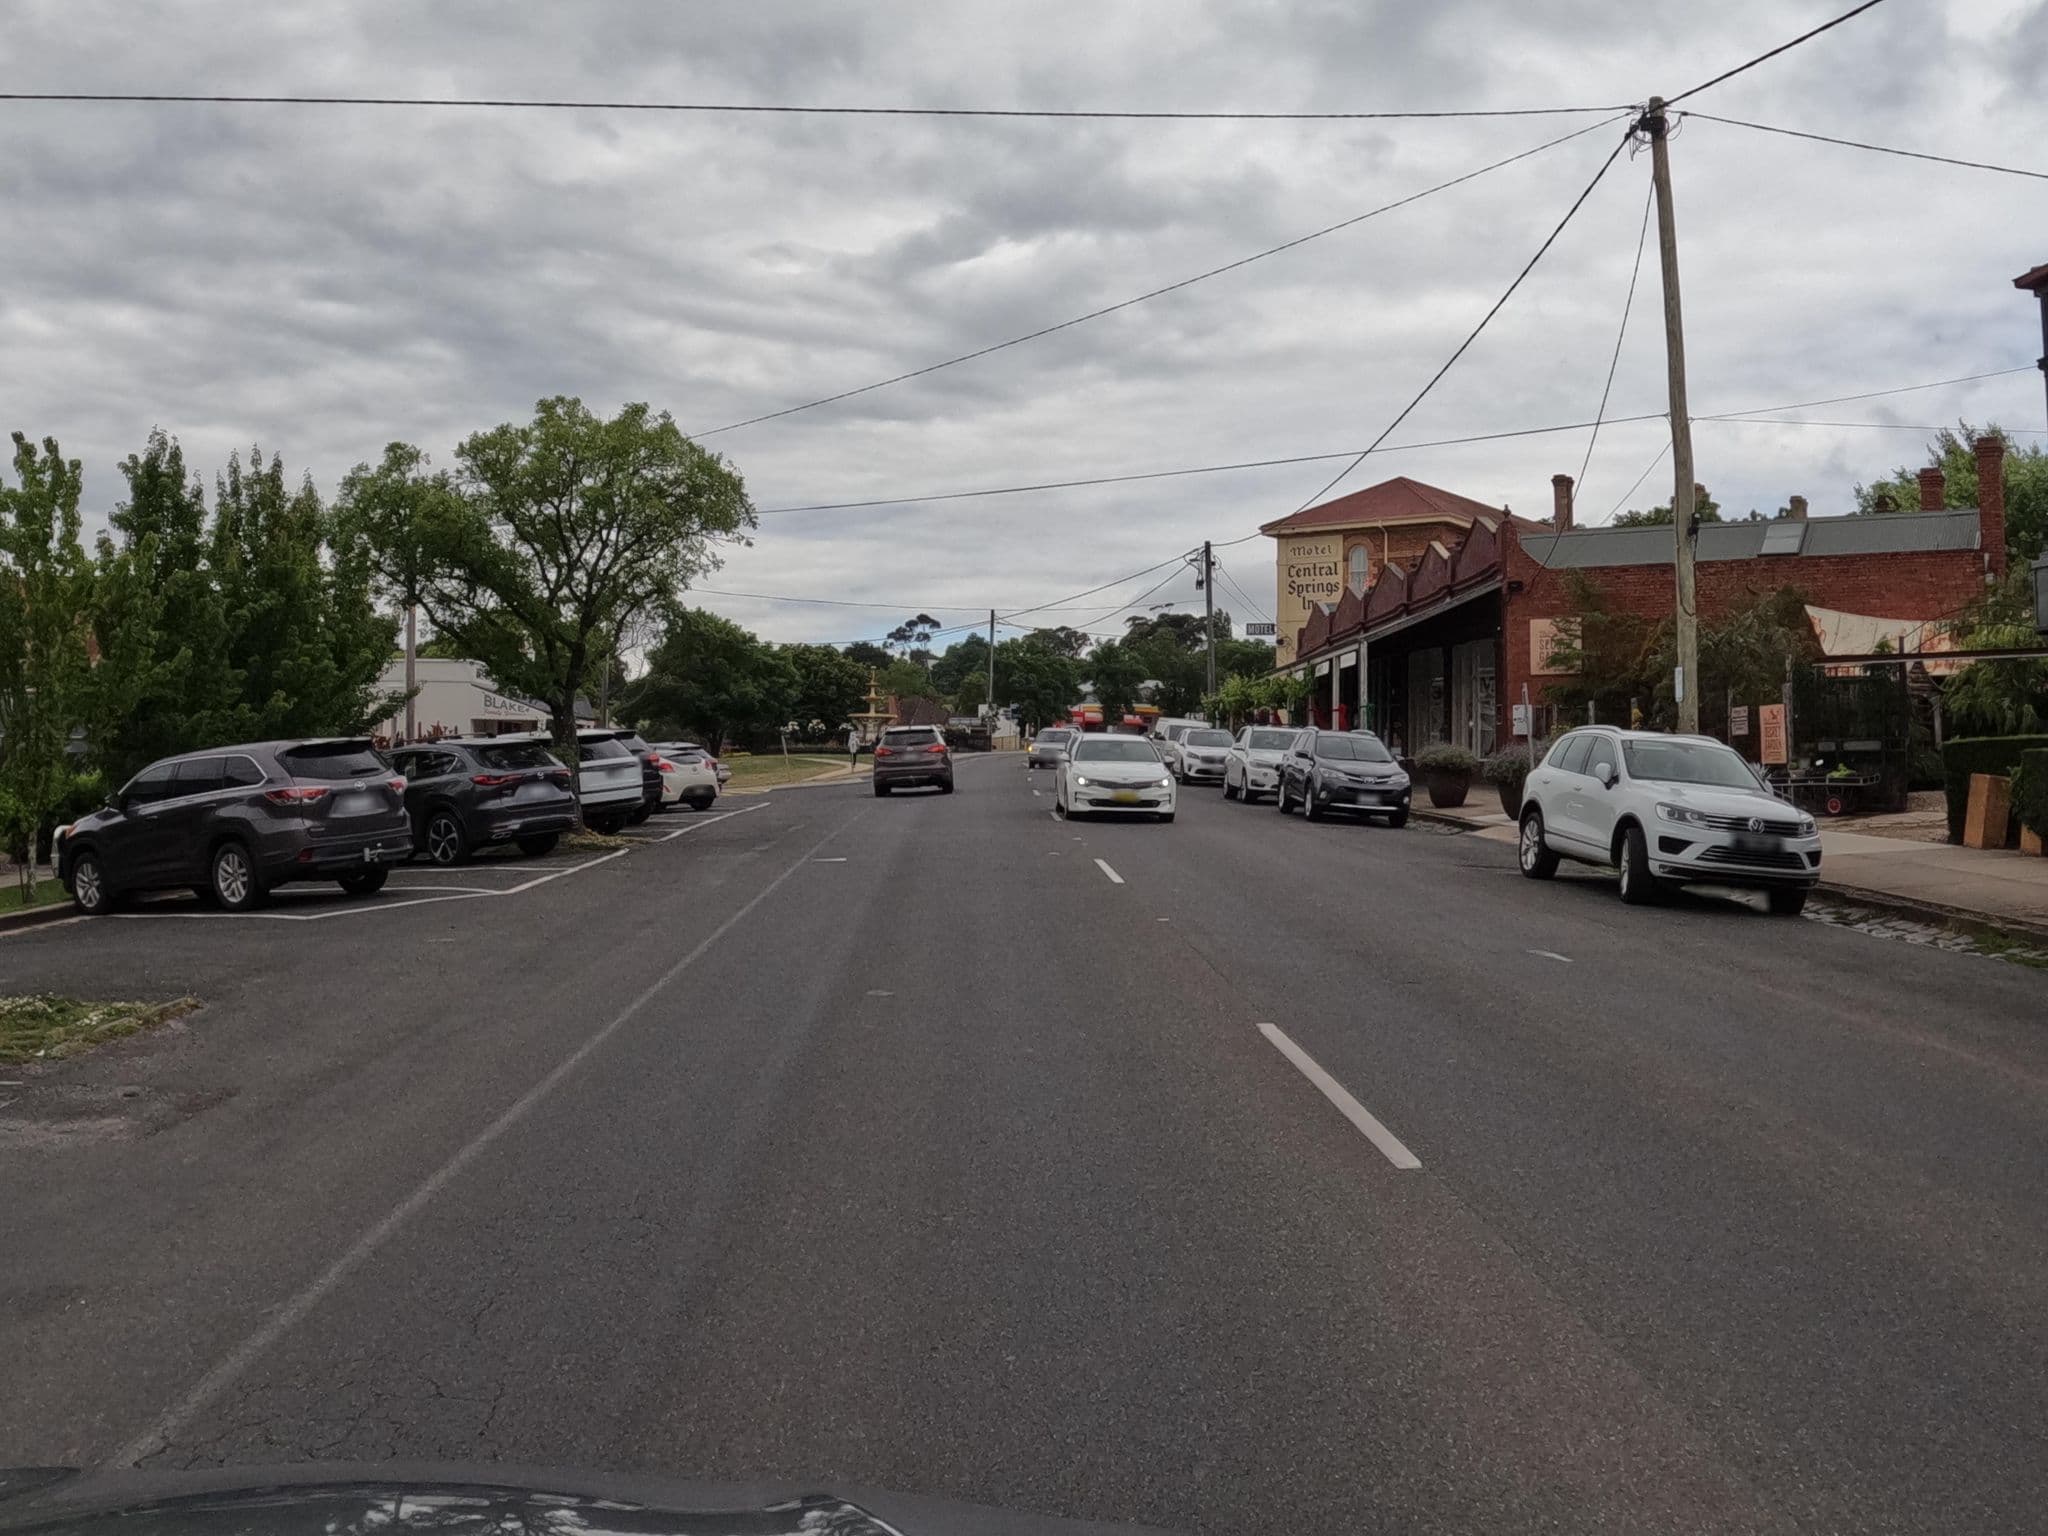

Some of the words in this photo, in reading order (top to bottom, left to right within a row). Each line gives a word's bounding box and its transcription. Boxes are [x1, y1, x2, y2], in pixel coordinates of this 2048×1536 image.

[1290, 545, 1332, 556] Motel
[1288, 562, 1338, 578] Central
[1288, 579, 1340, 597] Springs
[1302, 596, 1319, 610] In
[1248, 624, 1273, 634] MOTEL
